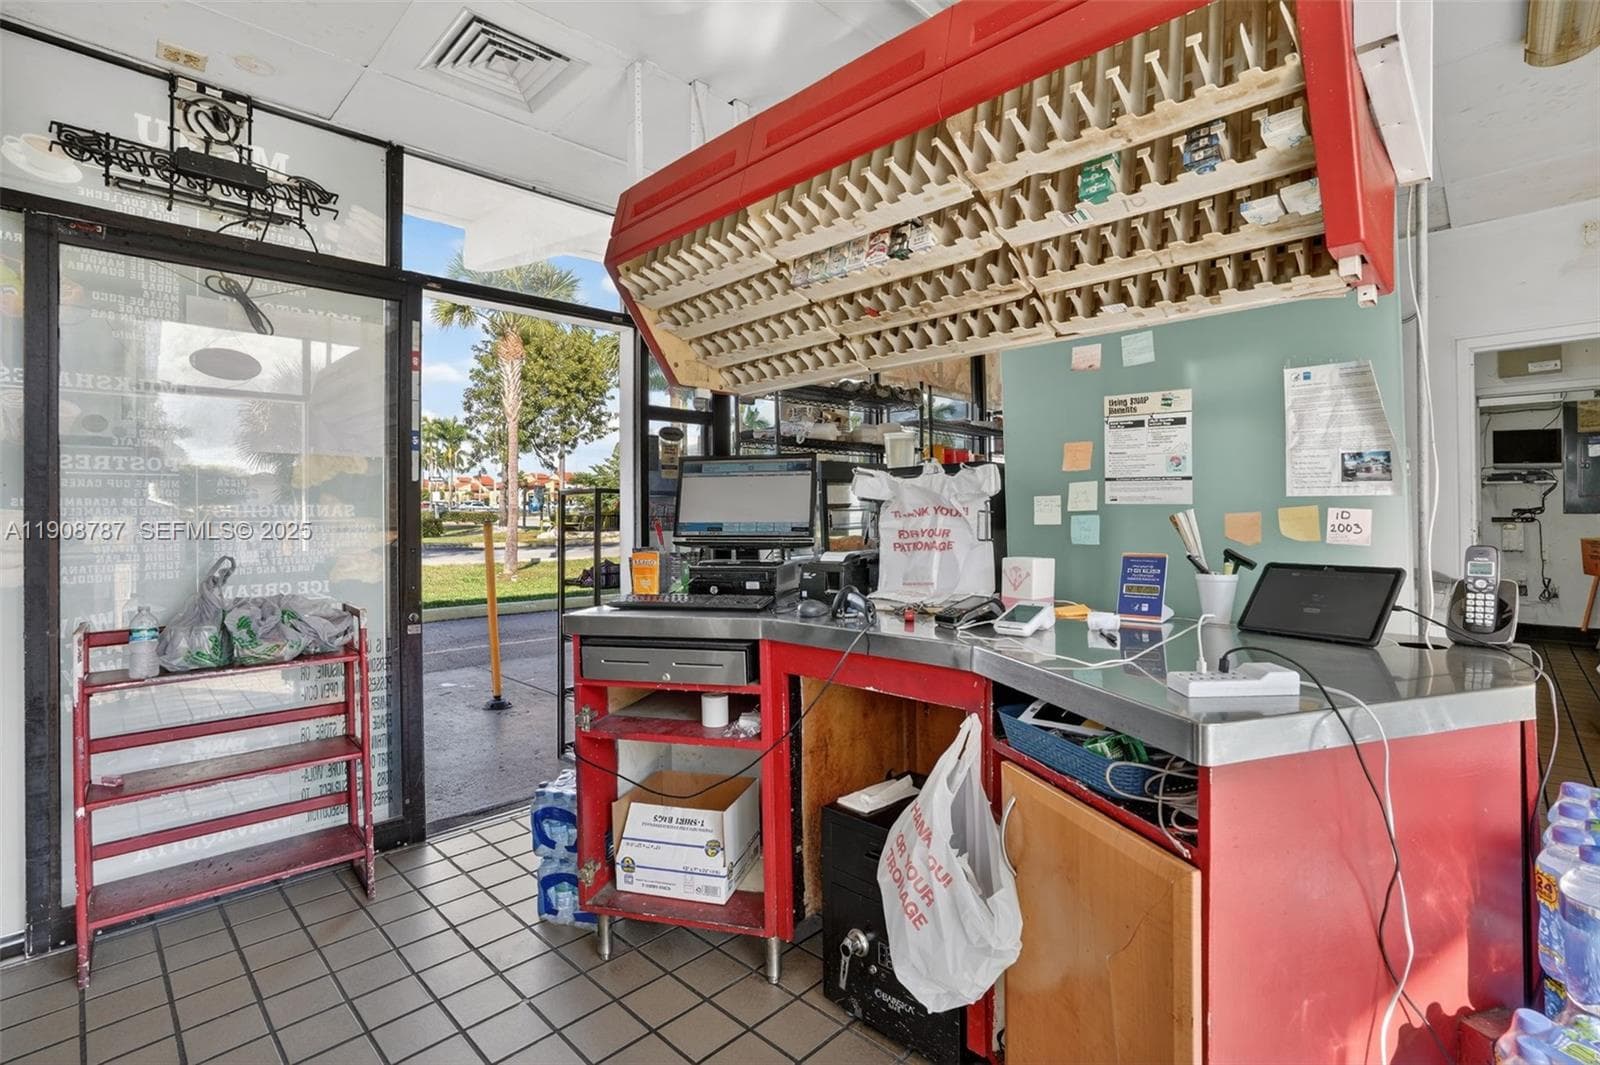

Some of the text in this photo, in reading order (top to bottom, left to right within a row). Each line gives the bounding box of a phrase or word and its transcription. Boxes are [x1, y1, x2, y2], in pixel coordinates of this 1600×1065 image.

[920, 528, 951, 540] YOUR
[1330, 523, 1363, 535] 2003
[905, 854, 935, 908] YOUR
